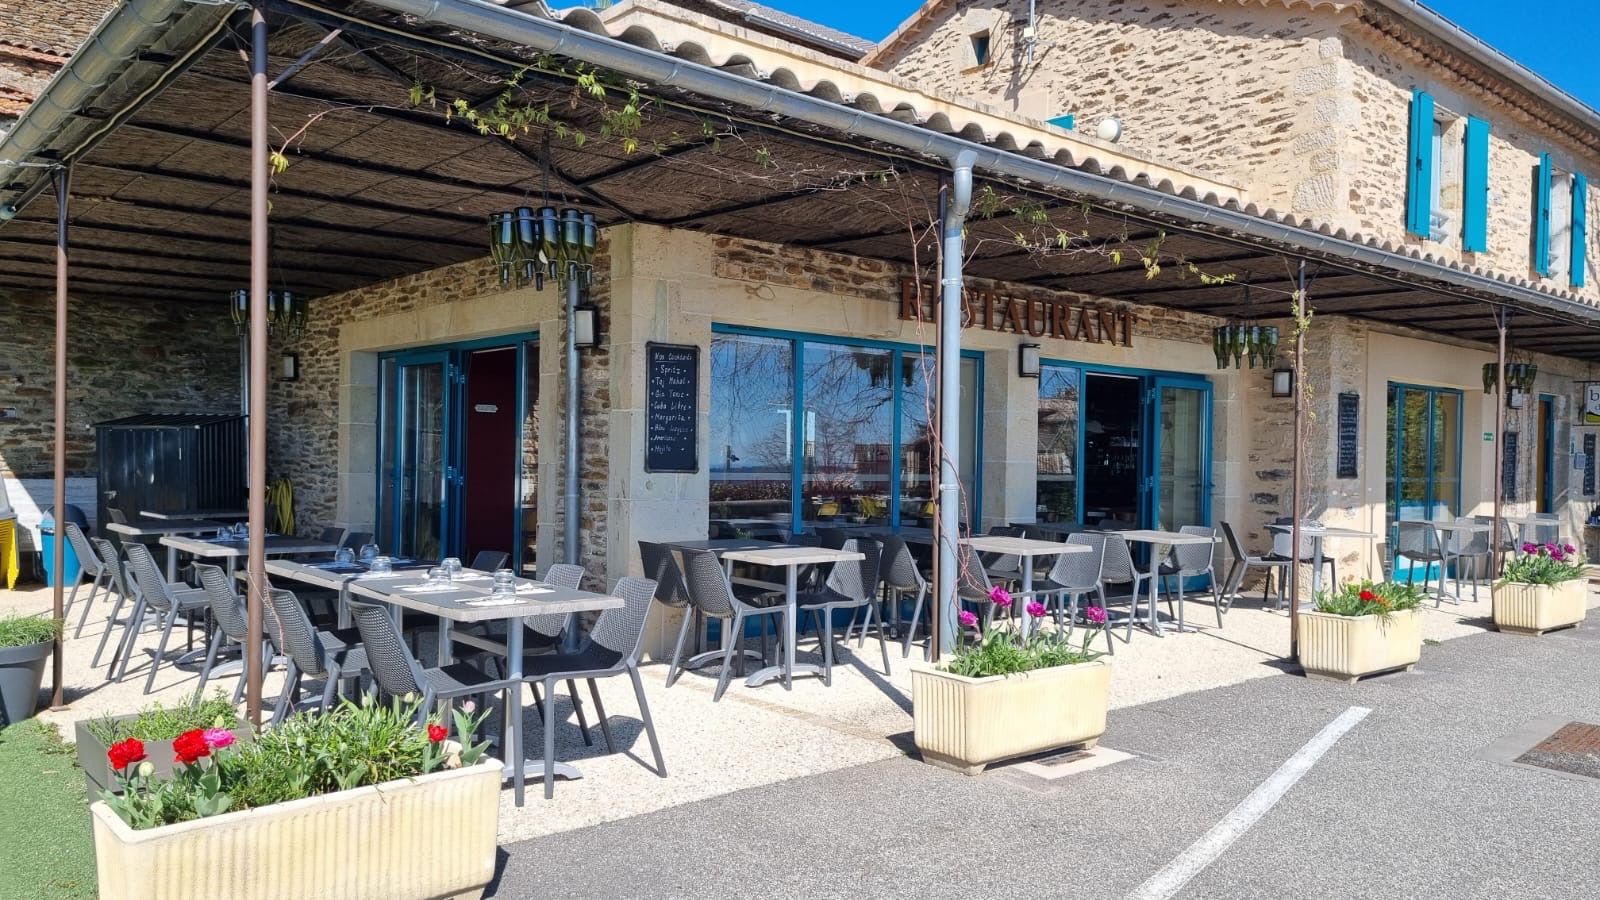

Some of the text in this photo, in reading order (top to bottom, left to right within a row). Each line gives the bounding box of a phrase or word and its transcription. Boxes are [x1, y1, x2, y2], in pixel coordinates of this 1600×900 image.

[655, 352, 665, 361] Nos
[660, 364, 681, 376] Spritz
[655, 376, 686, 388] Taj Mahal
[654, 400, 687, 411] Cuba Libre
[655, 412, 686, 424] Margarita
[655, 444, 672, 455] Mojito
